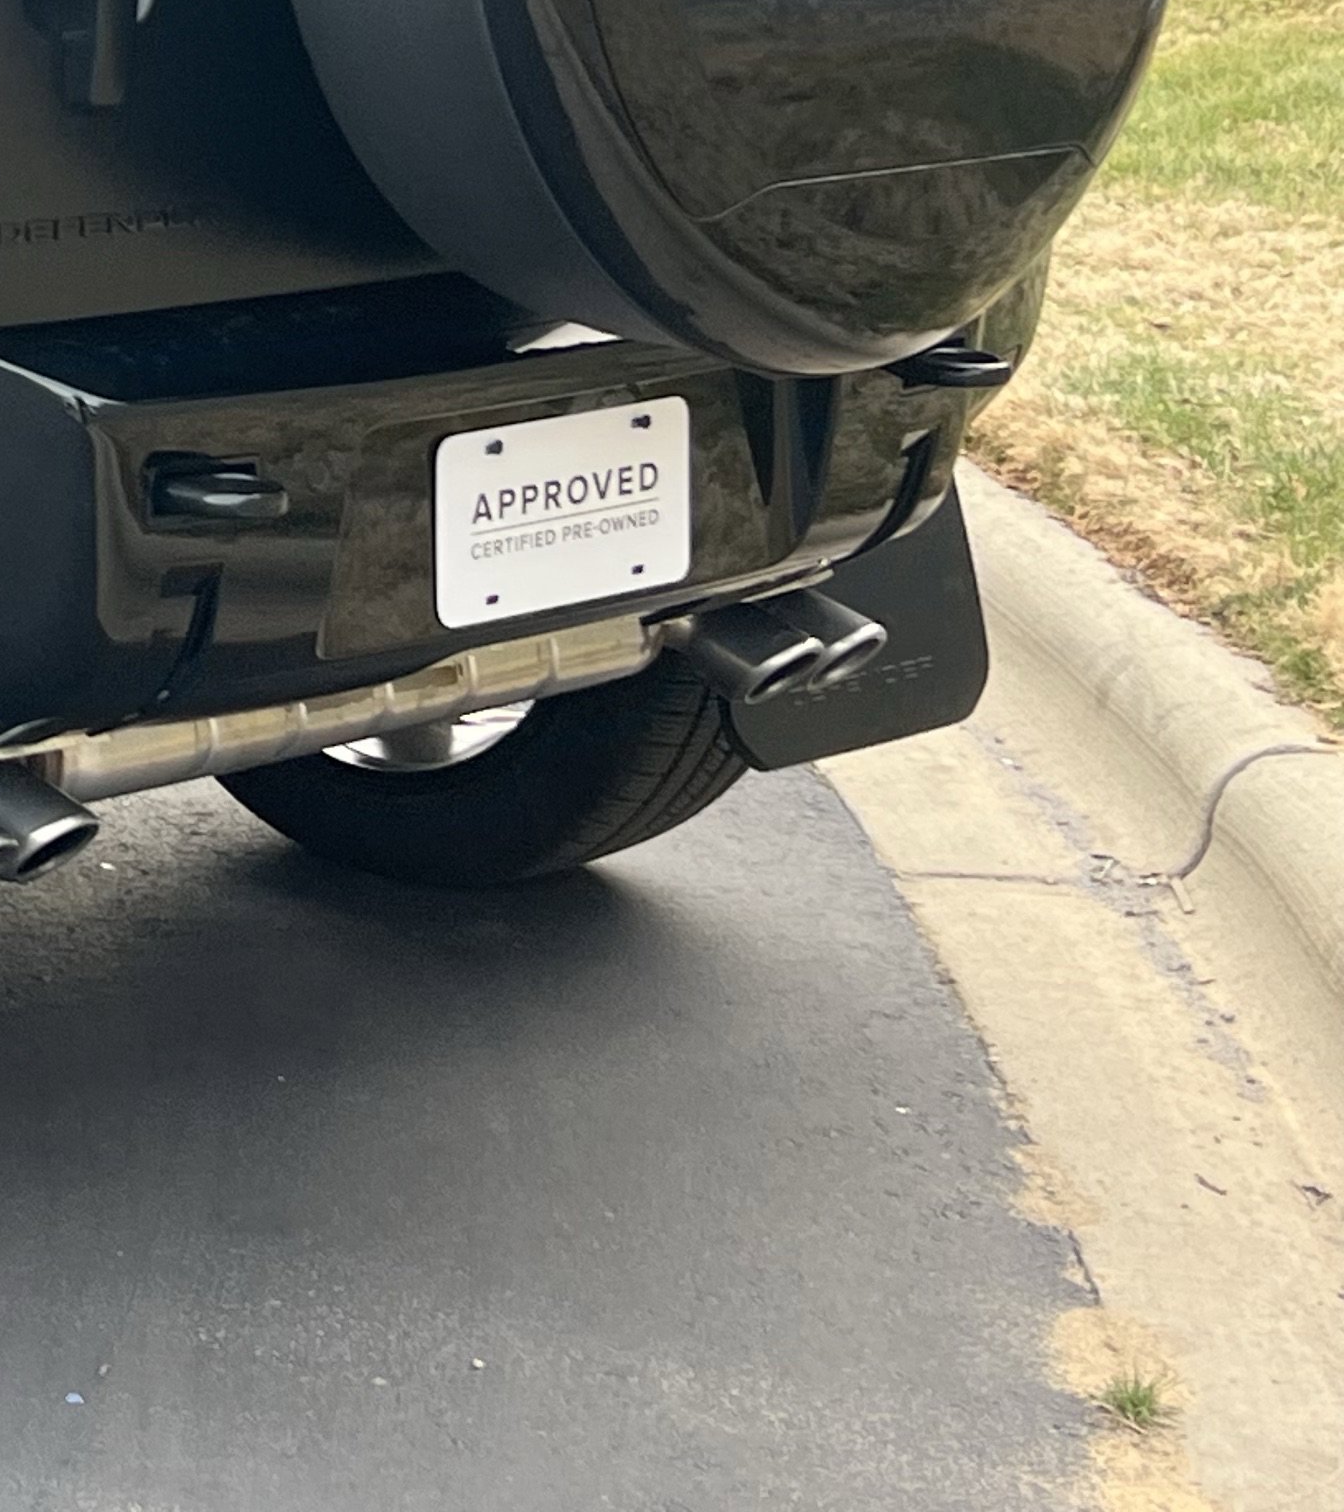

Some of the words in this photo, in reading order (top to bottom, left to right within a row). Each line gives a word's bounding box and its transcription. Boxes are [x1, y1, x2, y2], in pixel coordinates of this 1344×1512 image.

[471, 461, 660, 525] APPROVED
[470, 528, 557, 561] CERTIFIED
[561, 508, 660, 543] PRE-OWNED
